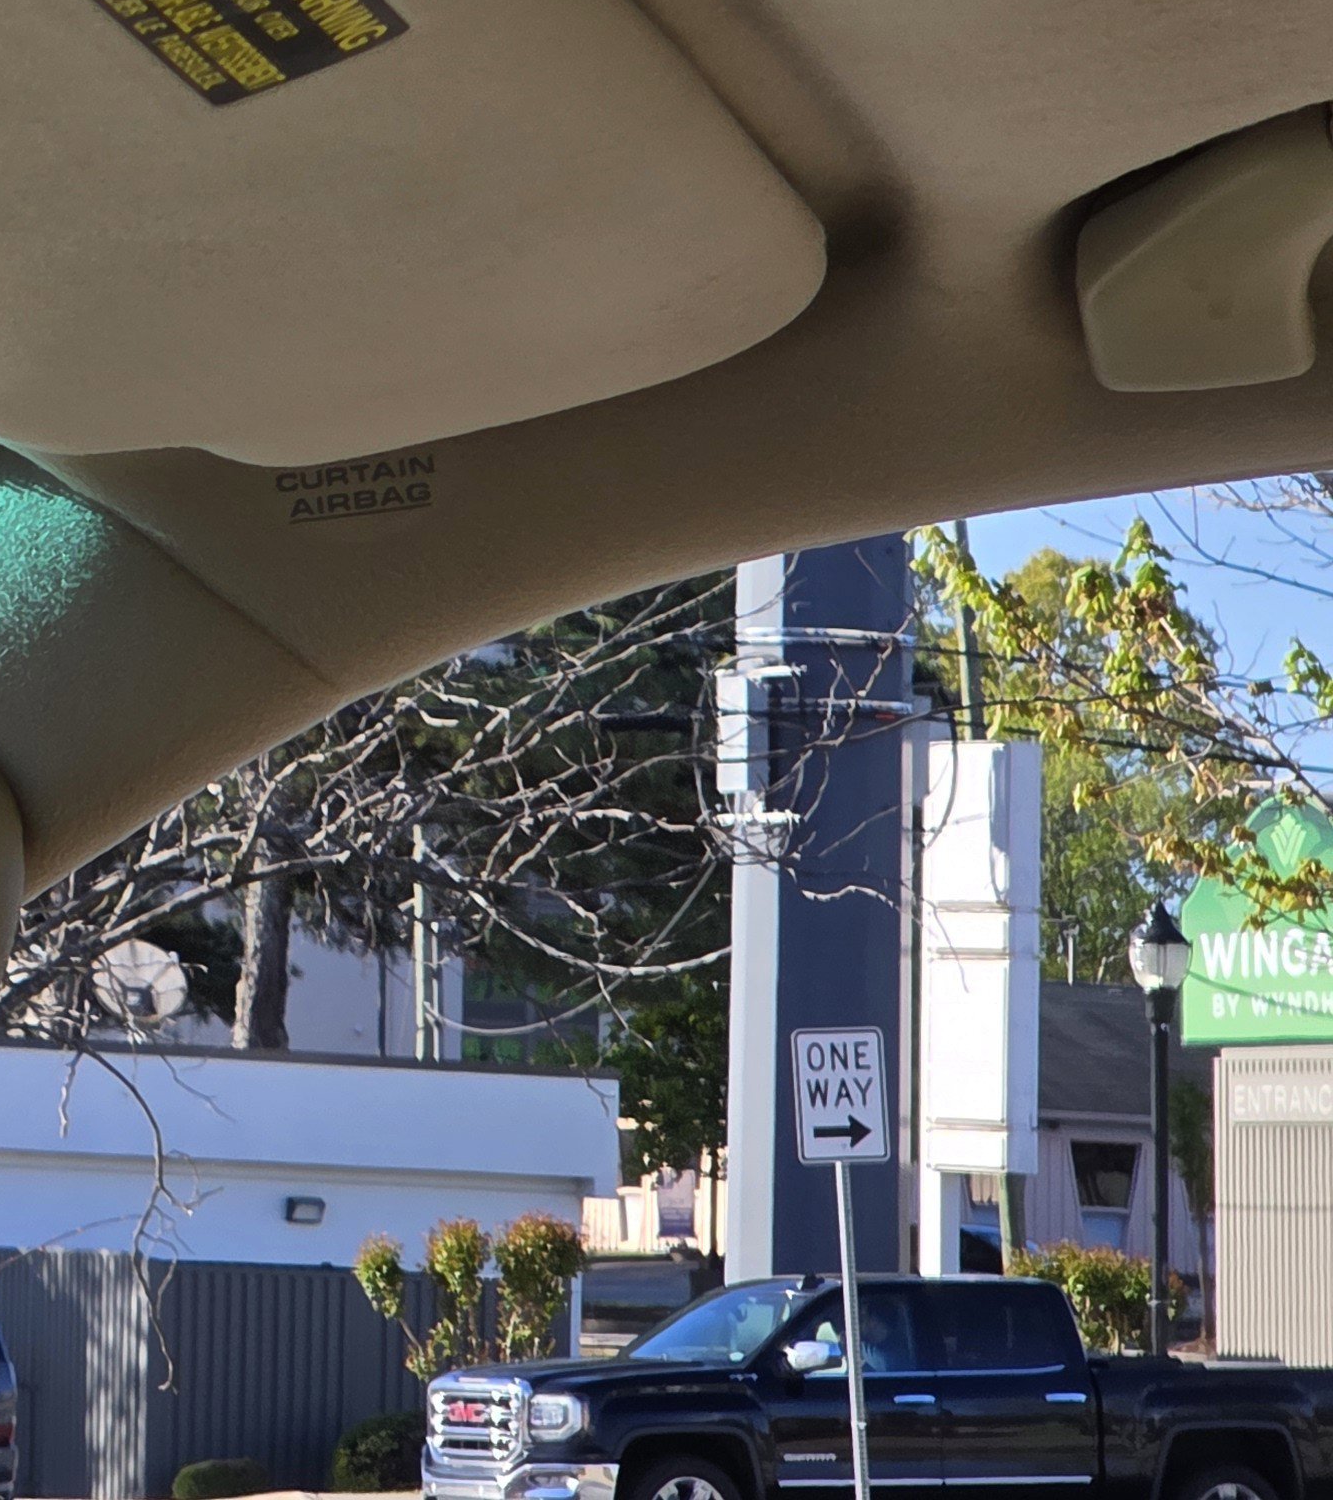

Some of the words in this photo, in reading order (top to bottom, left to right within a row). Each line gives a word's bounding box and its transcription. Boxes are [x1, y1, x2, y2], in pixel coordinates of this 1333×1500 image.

[275, 456, 434, 492] CURTAIN
[290, 482, 431, 517] AIRBAG
[1212, 992, 1240, 1018] BY
[807, 1040, 871, 1071] ONE
[806, 1077, 873, 1108] WAY
